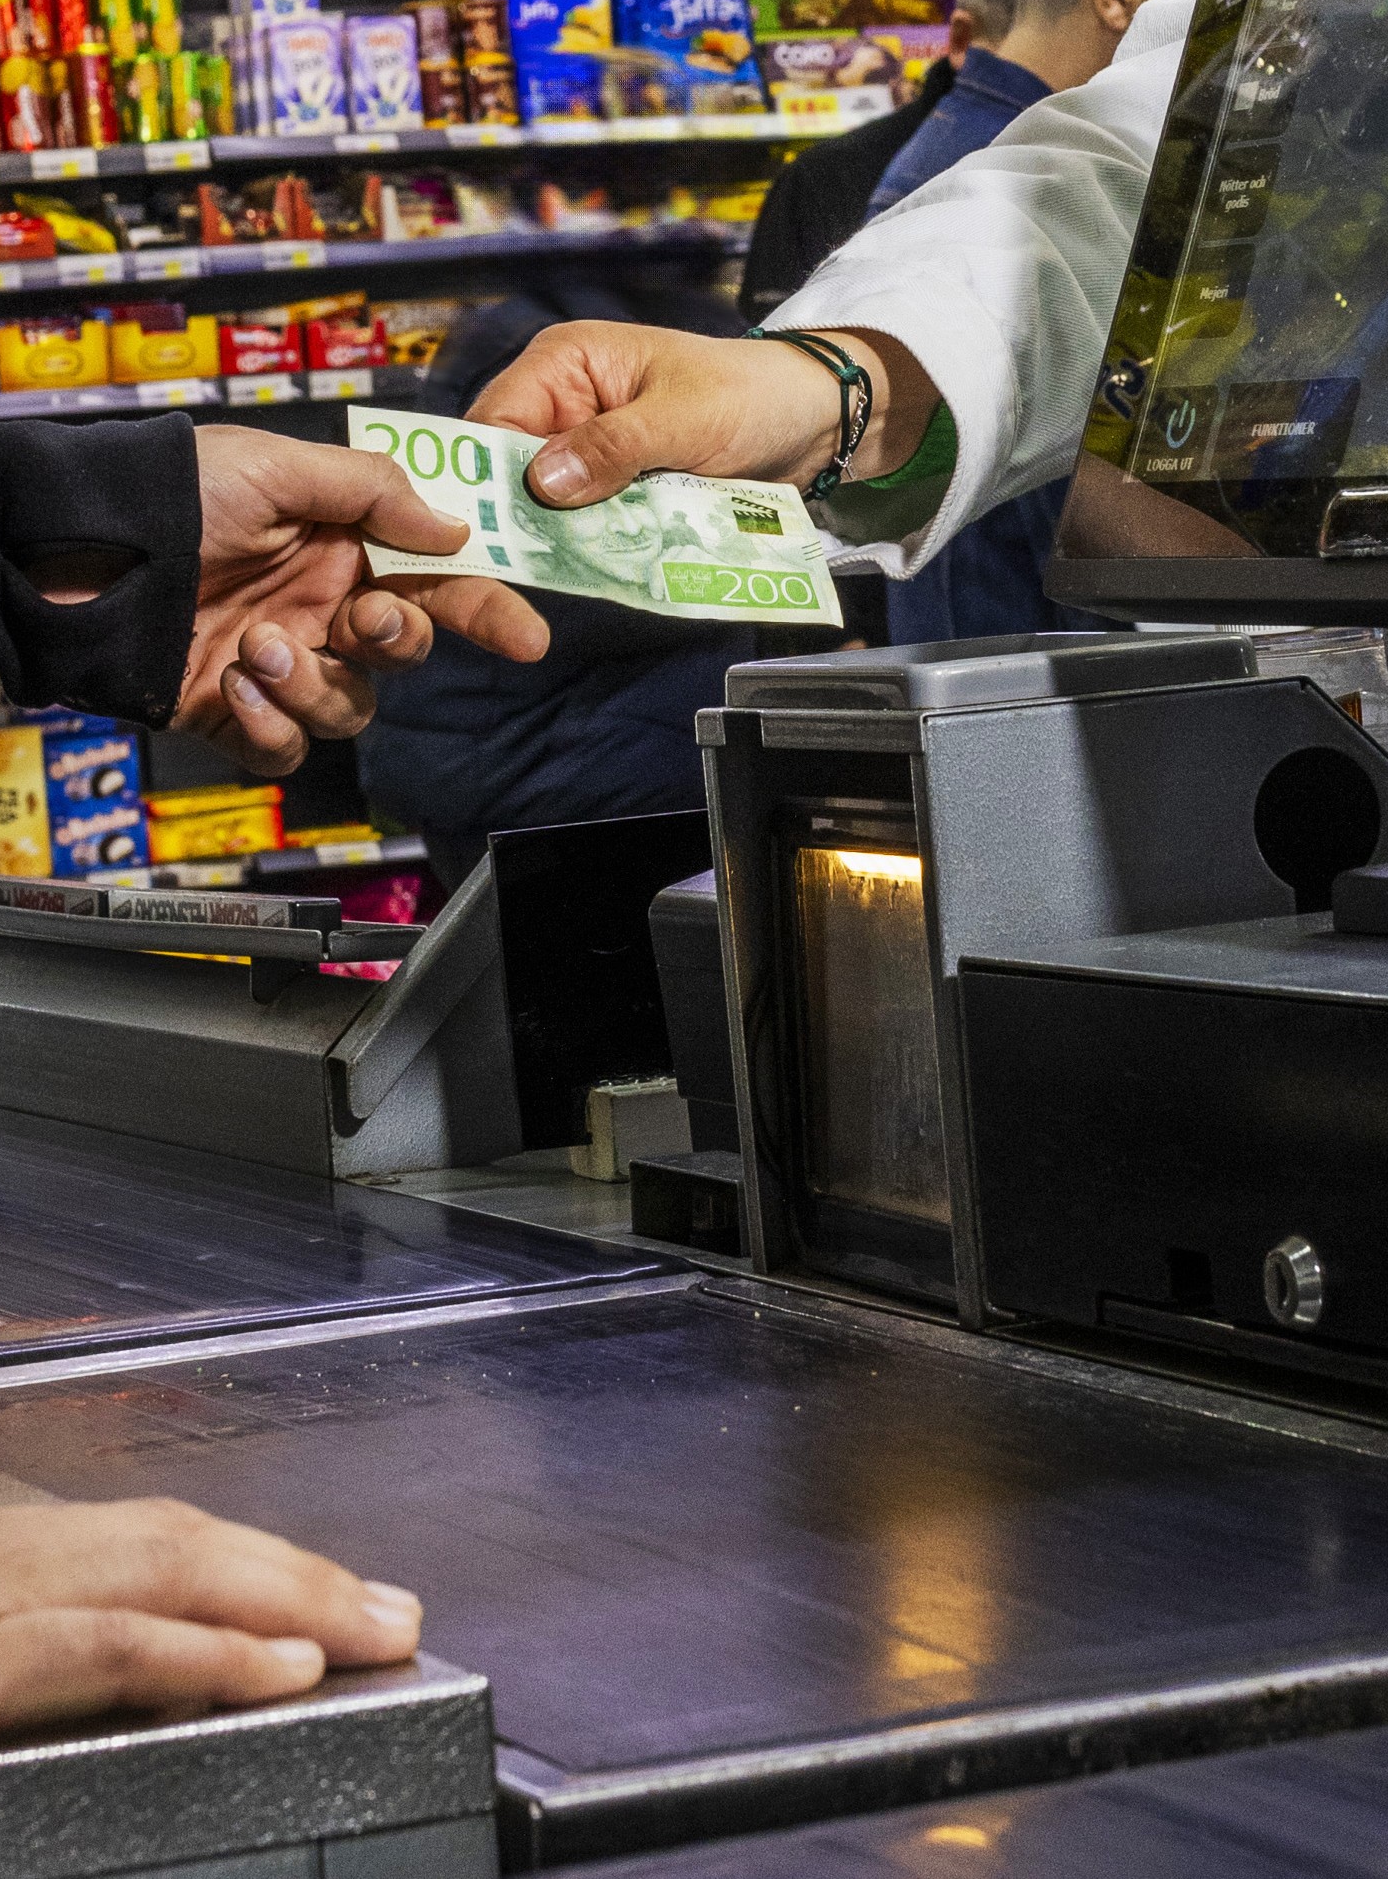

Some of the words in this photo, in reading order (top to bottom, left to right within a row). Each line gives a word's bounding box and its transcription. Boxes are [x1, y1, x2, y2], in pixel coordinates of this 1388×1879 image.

[1200, 284, 1230, 302] Mejeri
[1250, 422, 1316, 438] FUNKTIONER
[365, 423, 489, 486] 200
[1146, 459, 1178, 472] LOGGA
[1179, 457, 1195, 470] UT
[677, 475, 784, 503] KRONOR
[389, 560, 444, 568] SVERIGES
[447, 561, 502, 574] RIKSBANK
[715, 570, 814, 606] 200
